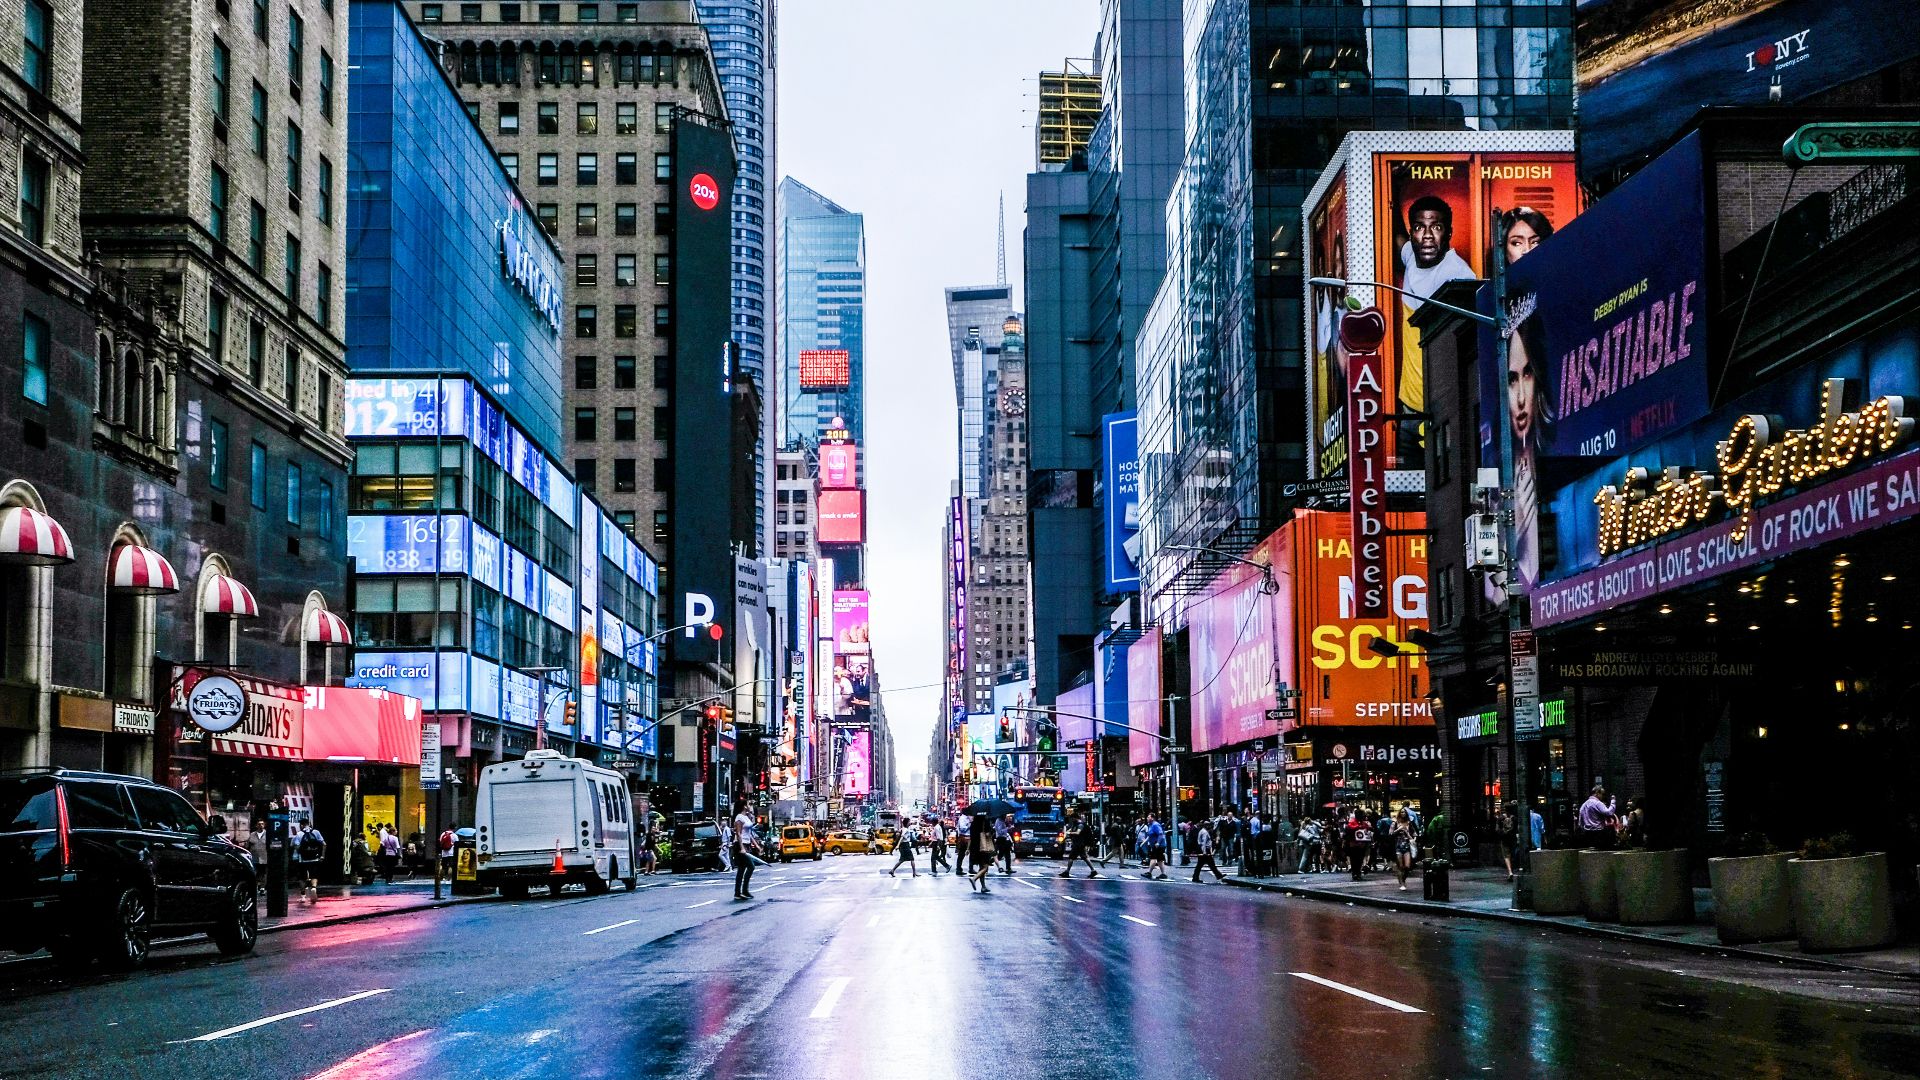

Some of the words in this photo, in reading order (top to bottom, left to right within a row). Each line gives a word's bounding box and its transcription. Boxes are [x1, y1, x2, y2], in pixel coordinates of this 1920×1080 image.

[1745, 51, 1756, 73] I
[1775, 53, 1810, 71] iloveny.com
[1411, 166, 1454, 180] HART
[1481, 166, 1552, 180] HADDISH
[694, 183, 716, 201] 20x
[1594, 295, 1618, 322] DEBBY
[1618, 288, 1639, 307] RYAN
[1640, 278, 1649, 294] IS
[1558, 280, 1697, 421] INSATIABLE
[1323, 405, 1344, 449] NIGHT
[1630, 398, 1677, 439] NETFLIX
[1580, 434, 1602, 456] AUG
[1604, 428, 1616, 451] 10
[1321, 434, 1348, 479] SCHOOL
[1716, 378, 1915, 545] Garden
[1319, 485, 1349, 494] SPECTACOLO
[1352, 364, 1384, 609] Applebee's
[1593, 466, 1720, 556] Winter
[402, 518, 460, 544] 1692
[953, 498, 963, 582] LADY
[1318, 538, 1354, 558] HA
[1538, 592, 1559, 621] FOR
[1561, 580, 1594, 613] THOSE
[1597, 567, 1636, 604] ABOUT
[1639, 560, 1655, 593] TO
[1658, 546, 1693, 584] LOVE
[1697, 524, 1758, 572] SCHOOL
[1762, 513, 1786, 551] OF
[1790, 494, 1844, 543] ROCK,
[1848, 481, 1880, 524] WE
[738, 563, 758, 576] wrinkles
[738, 580, 747, 589] can
[747, 582, 758, 592] now
[758, 582, 764, 594] be
[1311, 624, 1428, 670] SCH
[358, 663, 397, 678] credit
[400, 663, 430, 678] card
[1230, 640, 1275, 710] SCHOOL
[1559, 664, 1584, 677] HAS
[1586, 664, 1650, 677] BROADWAY
[1655, 664, 1709, 677] ROCKING
[199, 699, 236, 709] FRIDAY'S
[1355, 702, 1433, 718] SEPTEM
[1545, 699, 1566, 728] COFFEE
[122, 710, 149, 727] FRIDAY'S
[243, 703, 292, 741] RIDAY'S
[1481, 711, 1498, 736] COFFEE
[274, 821, 281, 831] P
